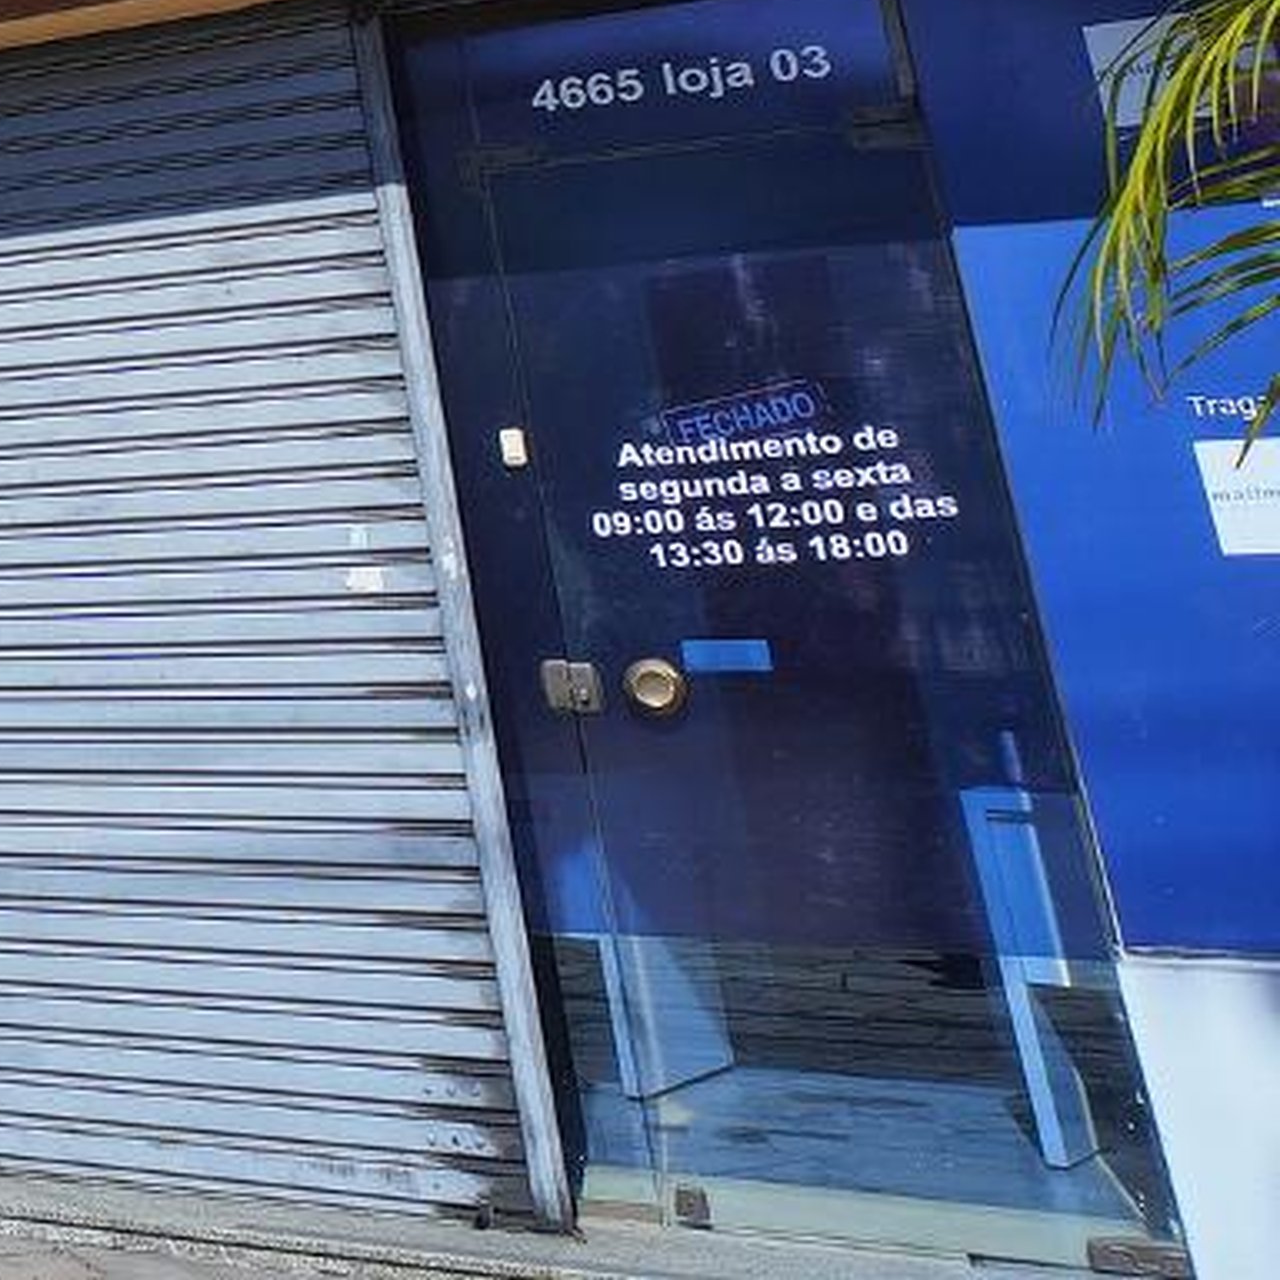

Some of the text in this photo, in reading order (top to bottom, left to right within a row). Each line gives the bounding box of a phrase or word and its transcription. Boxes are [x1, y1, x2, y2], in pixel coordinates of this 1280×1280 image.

[531, 45, 832, 111] 4665 loja 03
[678, 392, 816, 443] FECHADO
[616, 424, 900, 468] Atendimento de
[617, 460, 912, 505] segunda a sexta
[591, 493, 960, 538] 09:00 ás 12:00 e das
[648, 529, 910, 569] 13:30 ás 18:00
